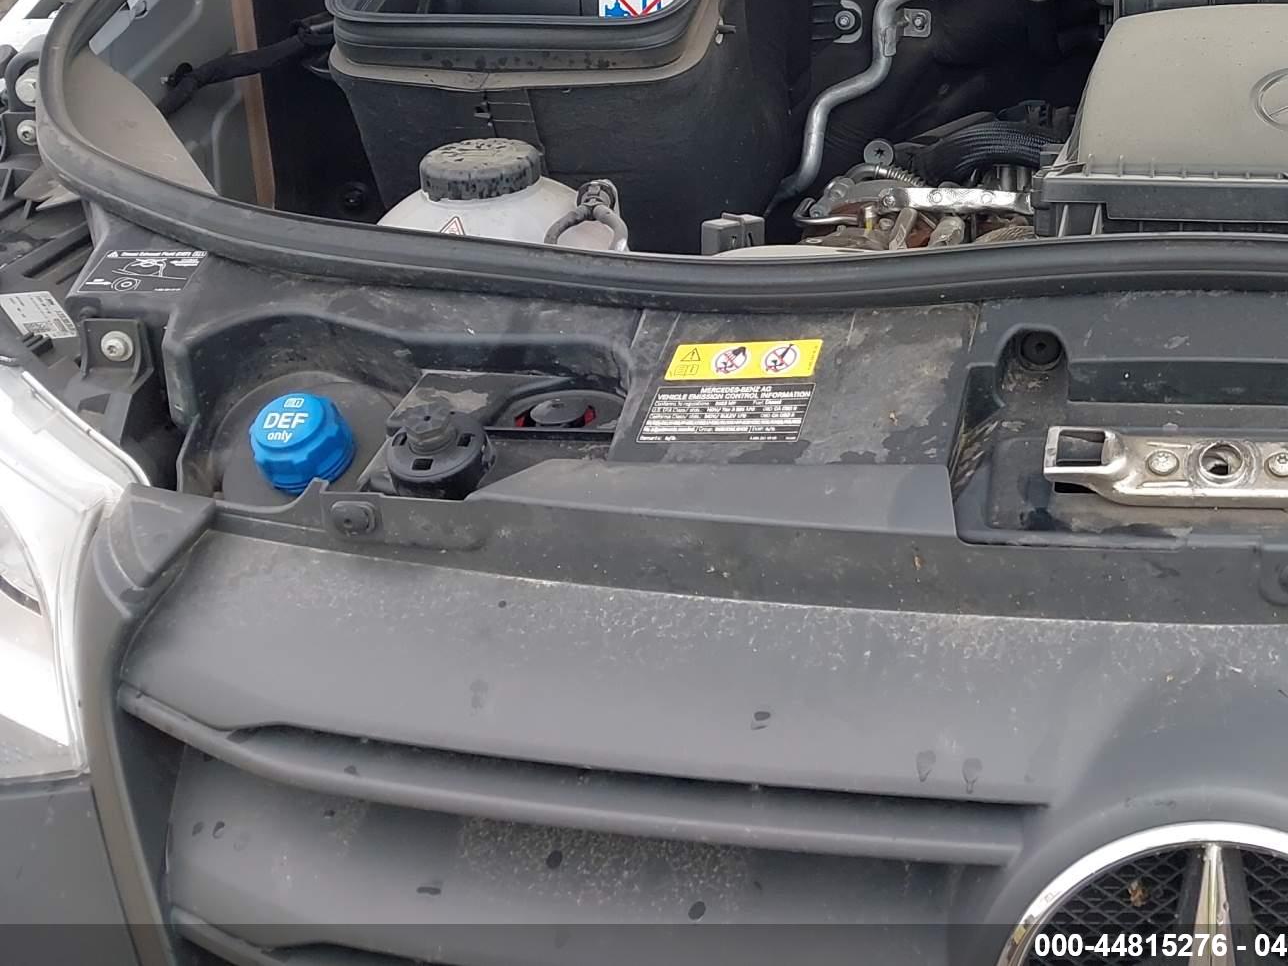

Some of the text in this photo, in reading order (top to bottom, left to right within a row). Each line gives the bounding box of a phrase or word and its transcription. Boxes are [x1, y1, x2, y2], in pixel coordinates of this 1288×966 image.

[701, 385, 772, 394] MERCEDES-BENZ AG
[657, 393, 687, 401] VEHICLE
[724, 392, 759, 400] CONTROL
[760, 390, 812, 399] INFORMATION
[263, 413, 308, 429] DEF
[267, 430, 292, 442] only
